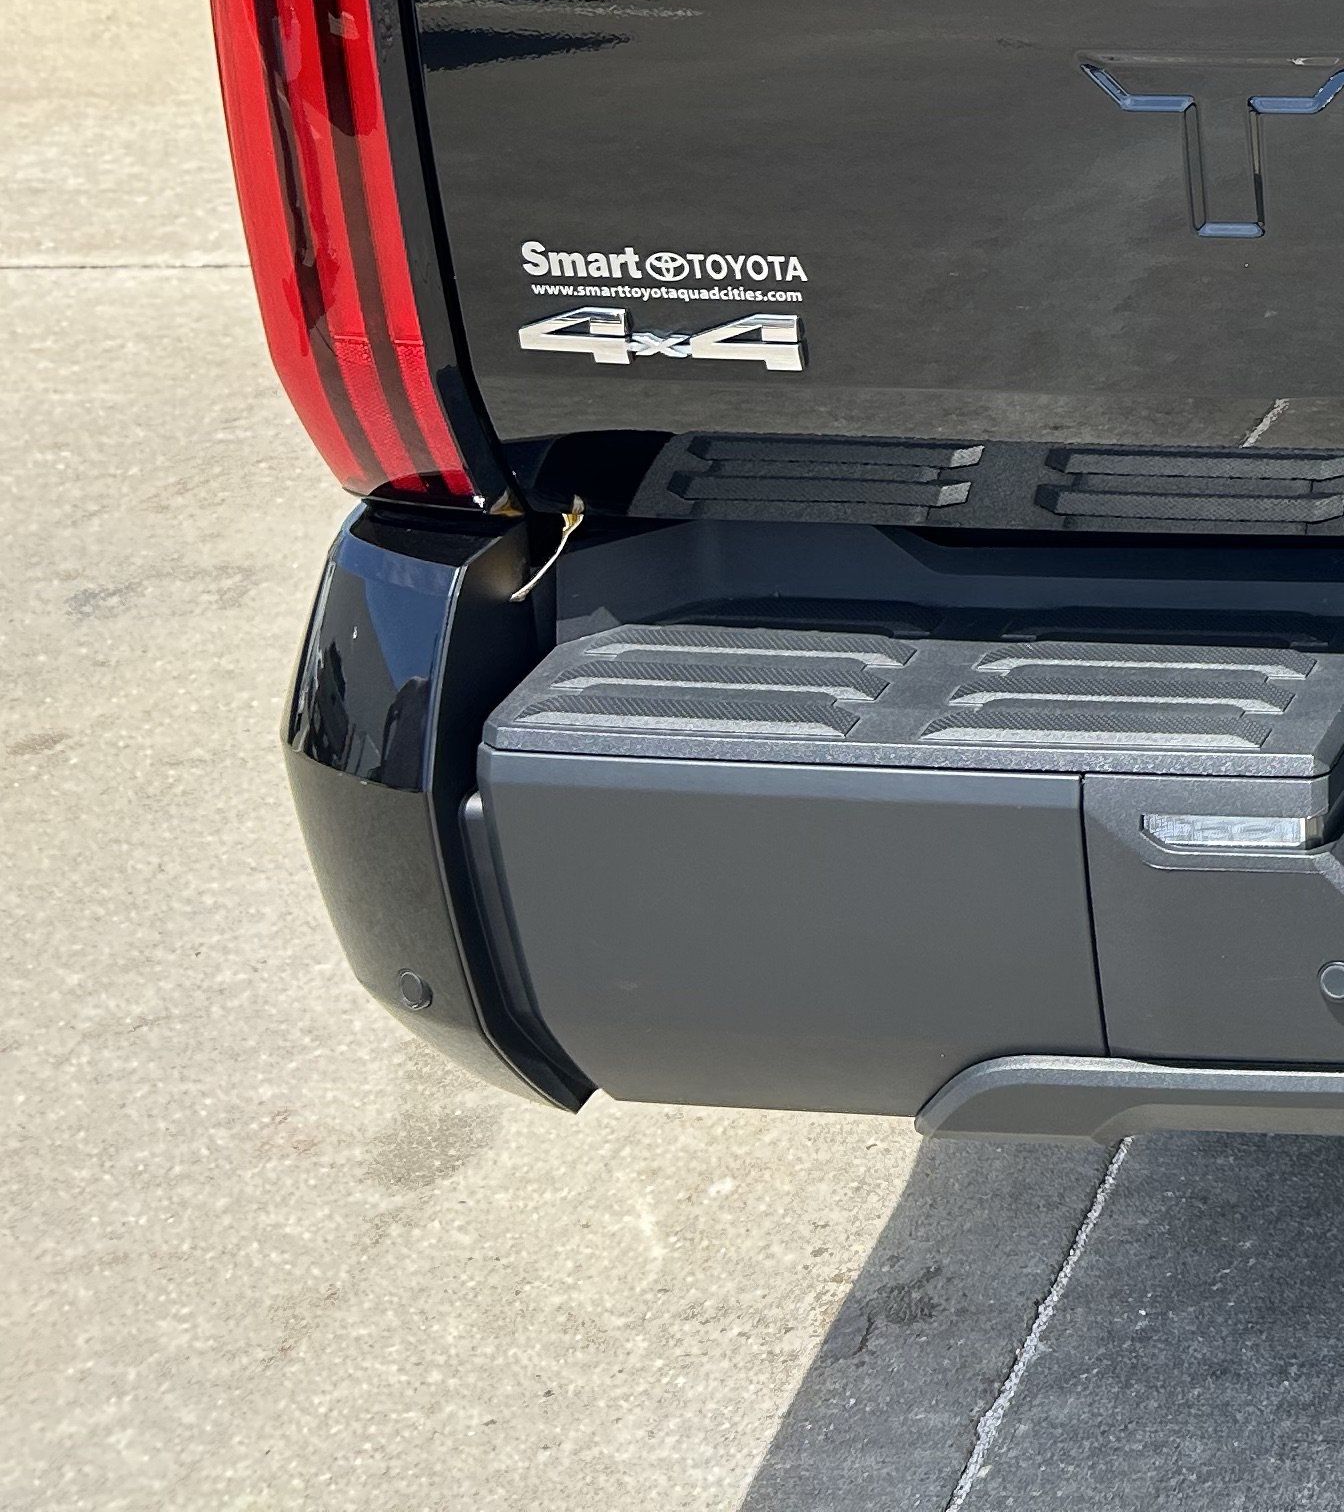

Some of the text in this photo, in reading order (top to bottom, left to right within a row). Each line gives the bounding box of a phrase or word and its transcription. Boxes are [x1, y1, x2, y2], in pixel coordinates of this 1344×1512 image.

[521, 241, 808, 282] Smart TOYOTA
[531, 283, 803, 302] www.smarttoyotaquadcities.com
